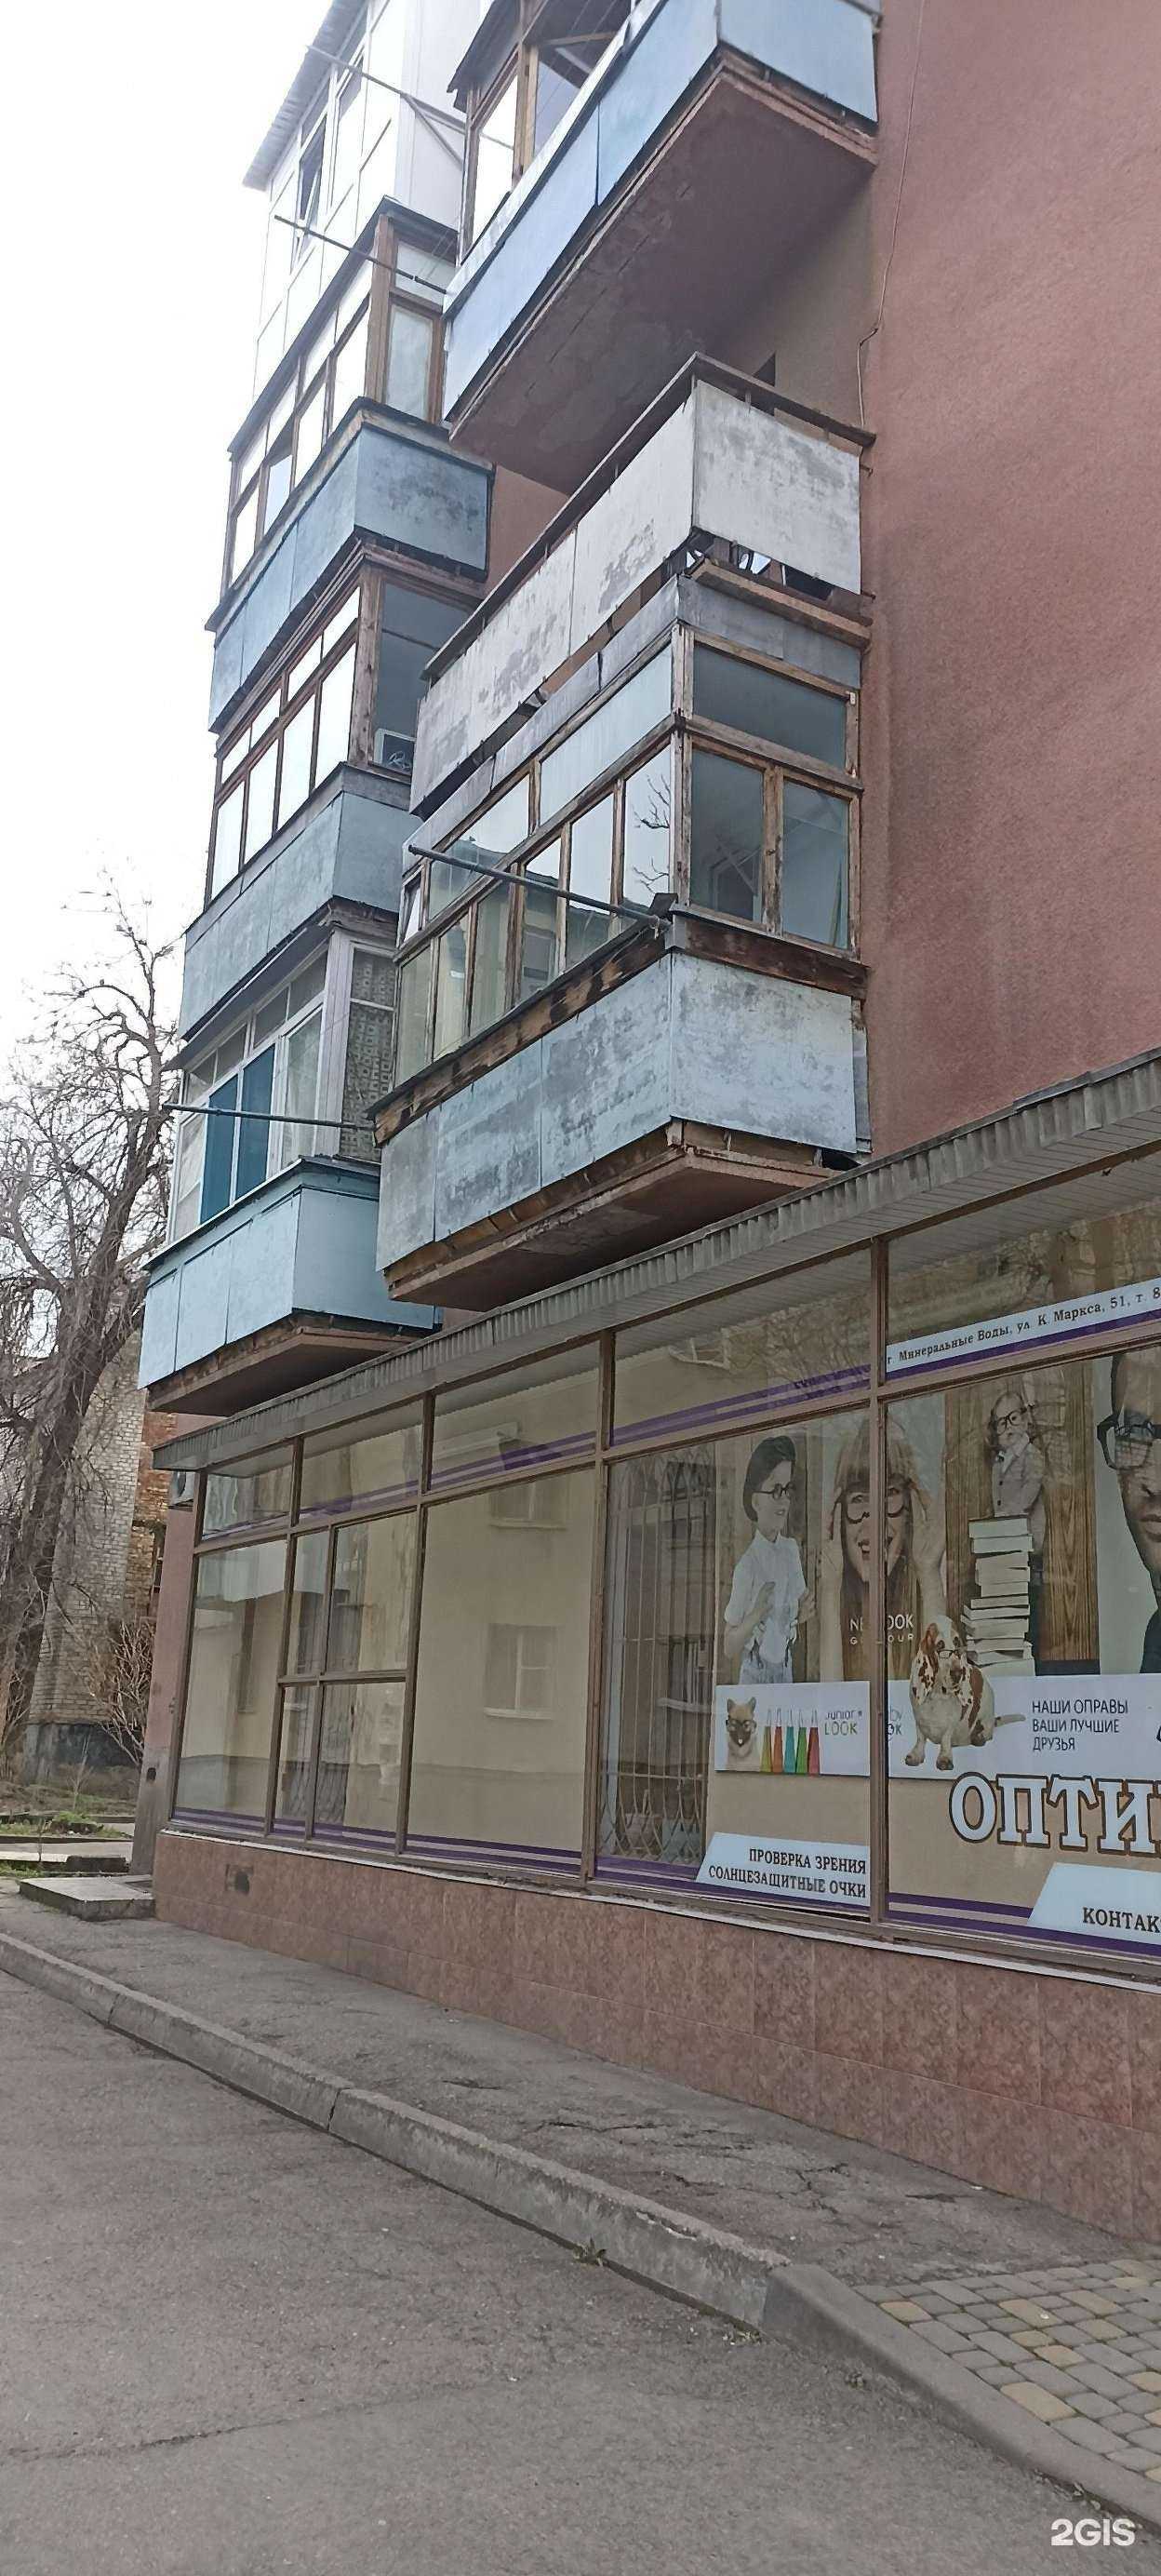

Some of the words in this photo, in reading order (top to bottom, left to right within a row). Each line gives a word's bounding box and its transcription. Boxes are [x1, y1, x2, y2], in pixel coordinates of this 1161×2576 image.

[899, 1335, 973, 1362] Минеральные
[1054, 1303, 1105, 1322] Маркса,
[1110, 1295, 1130, 1309] 51,
[1032, 1699, 1071, 1714] НАШИ
[1074, 1698, 1128, 1714] ОПРАВЫ
[824, 1721, 858, 1736] LOOK
[1033, 1718, 1067, 1732] ВАШИ
[1070, 1718, 1120, 1733] ЛУЧШИЕ
[1033, 1736, 1075, 1751] ДРУЗЬЯ
[949, 1771, 1161, 1858] ОПТИ
[749, 1848, 811, 1869] ПРОВЕРКА
[815, 1856, 866, 1874] ЗРЕНИЯ
[709, 1865, 826, 1894] СОЛНЦЕЗАЩИТНЫЕ
[829, 1880, 866, 1898] ОЧКИ
[1082, 1907, 1161, 1933] КОНТАК
